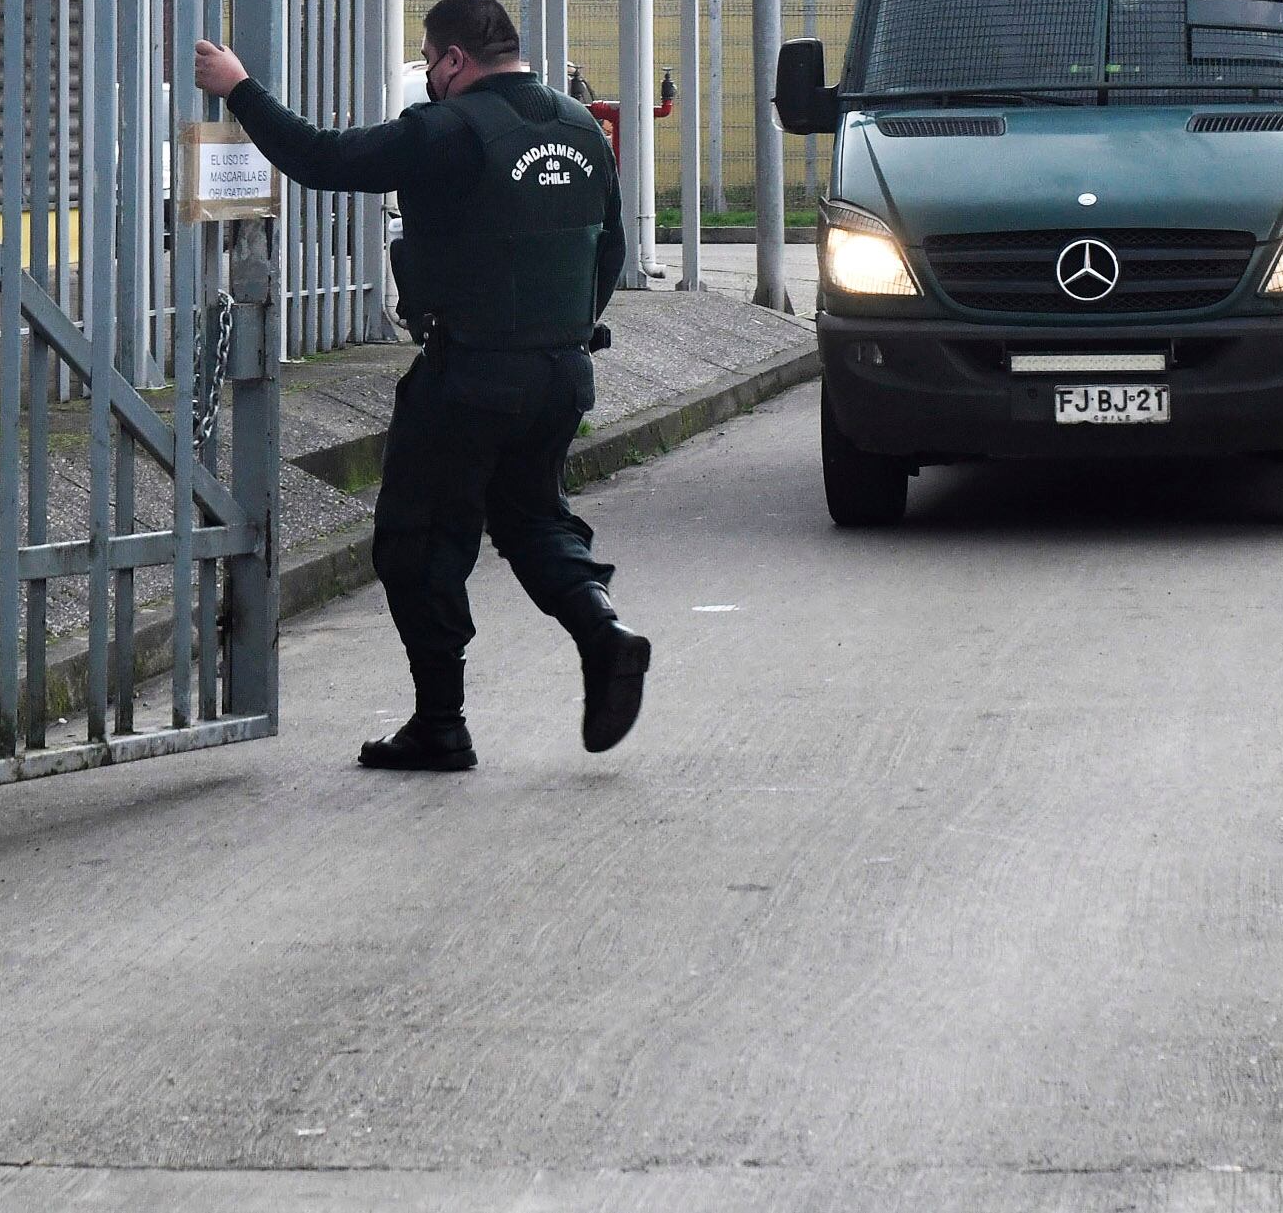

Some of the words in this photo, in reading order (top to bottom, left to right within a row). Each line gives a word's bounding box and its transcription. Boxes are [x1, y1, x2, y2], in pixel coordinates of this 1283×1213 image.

[211, 154, 221, 166] EL
[222, 154, 239, 166] USO
[239, 153, 250, 165] DE
[511, 143, 594, 181] GENDARMERIA
[545, 158, 560, 171] de
[210, 170, 256, 182] MASCARILLA
[257, 170, 268, 182] ES
[538, 171, 571, 186] CHILE
[1093, 414, 1132, 422] CHILE
